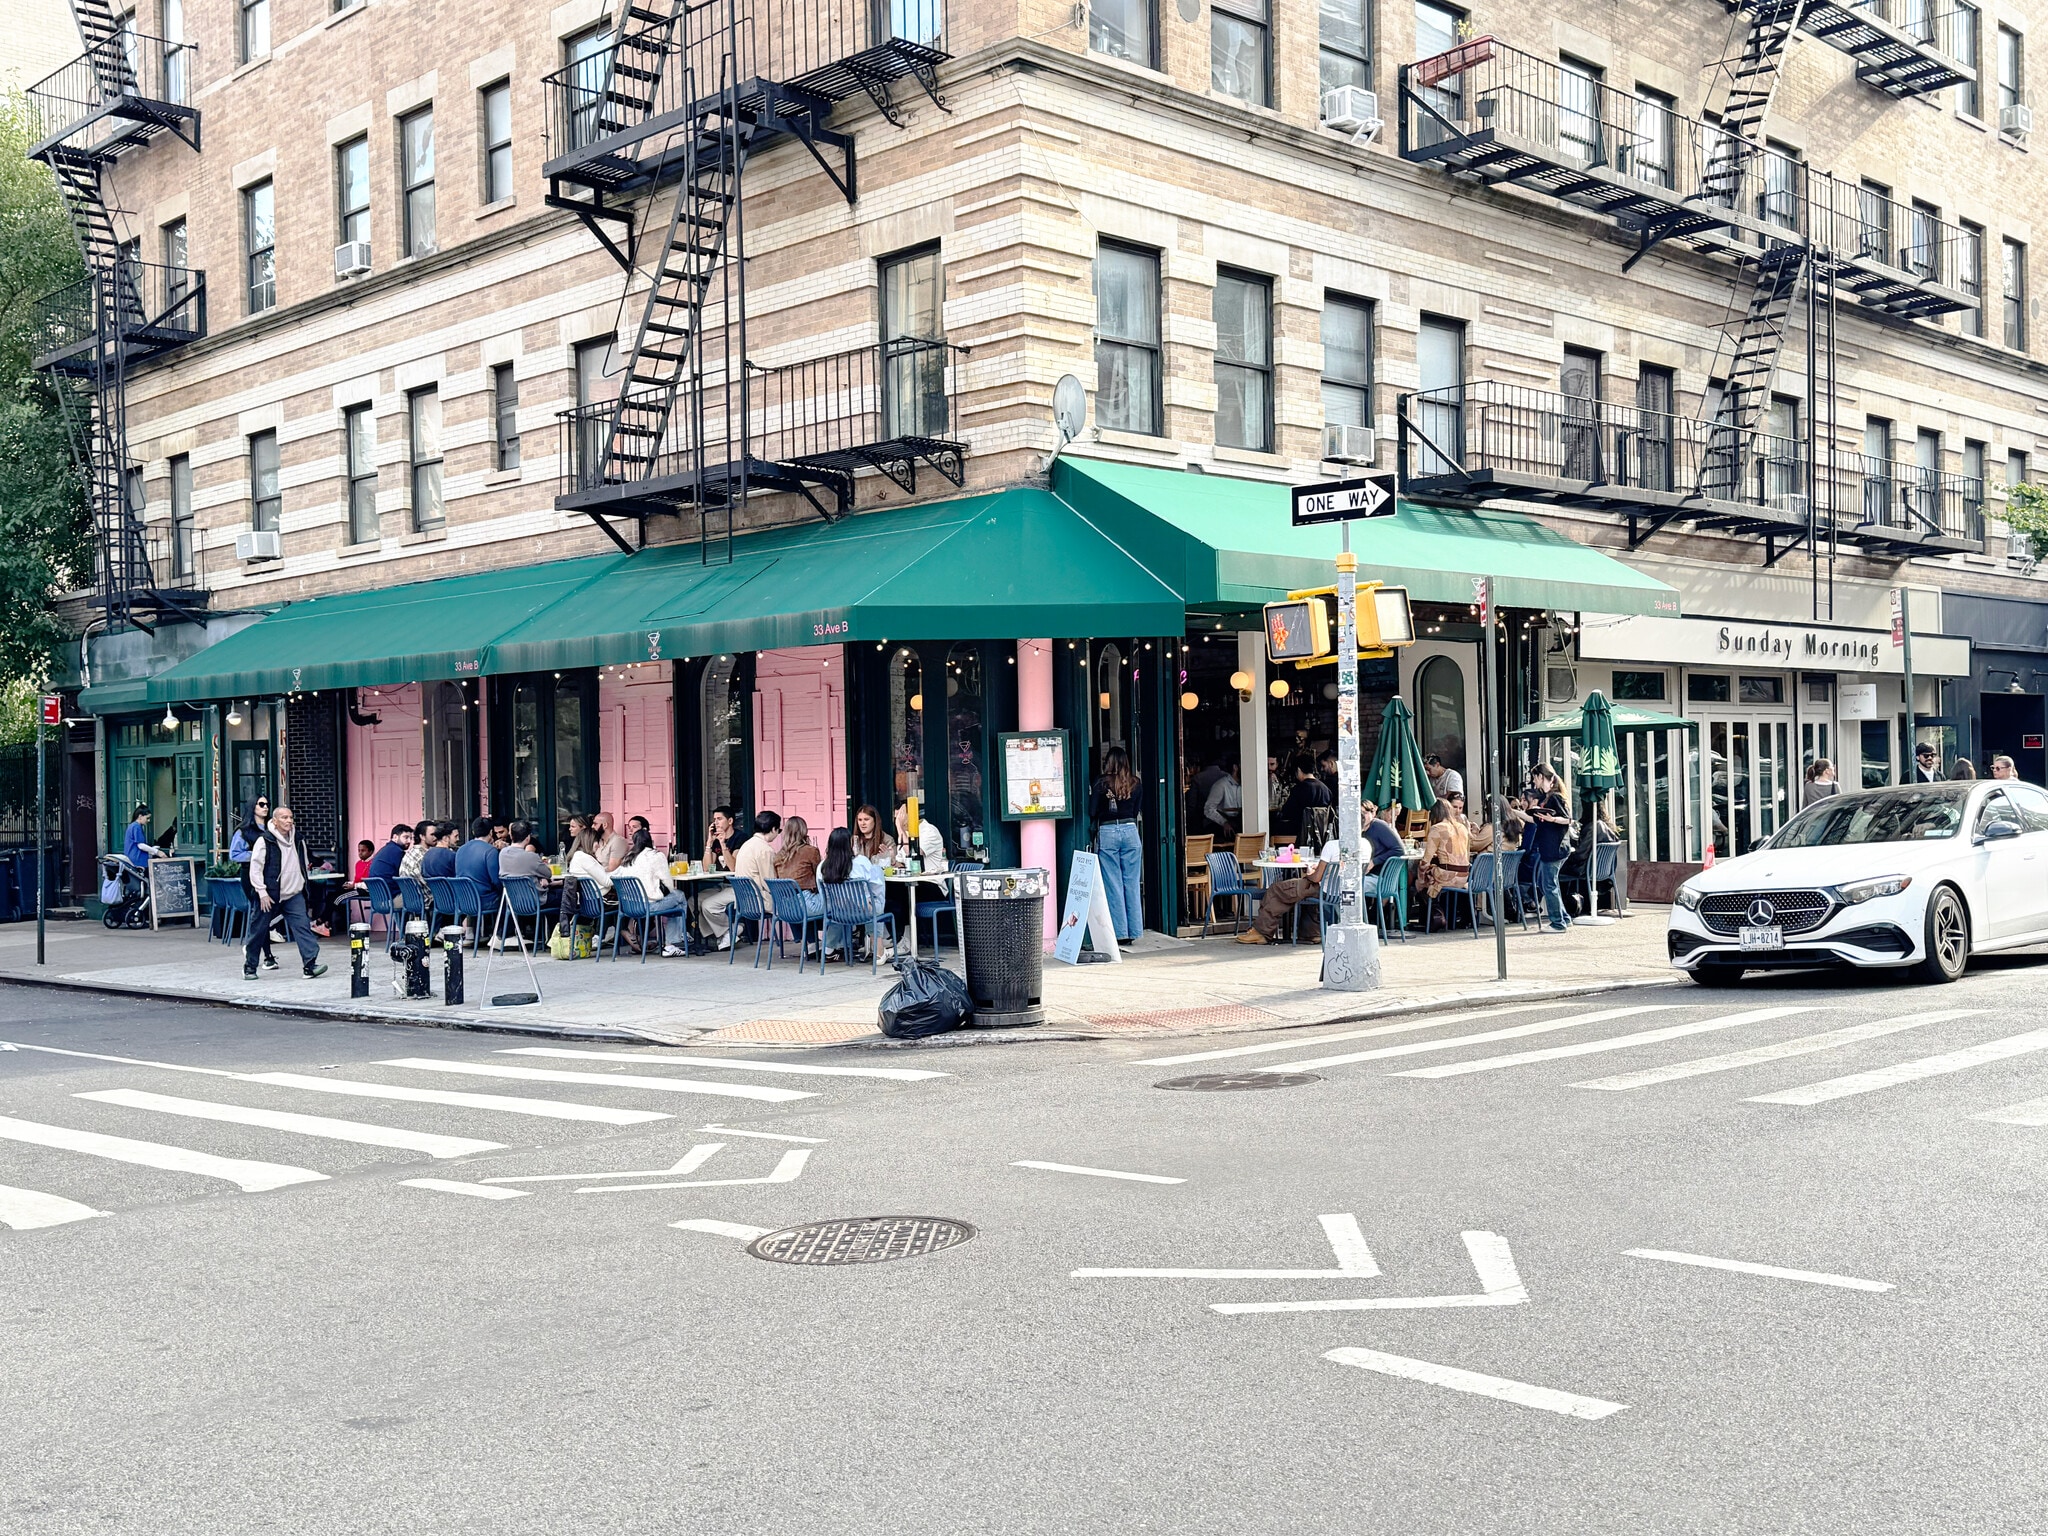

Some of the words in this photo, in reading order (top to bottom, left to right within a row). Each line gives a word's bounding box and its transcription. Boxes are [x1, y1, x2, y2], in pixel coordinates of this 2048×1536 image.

[1306, 494, 1335, 512] ONE
[1348, 488, 1379, 507] WAY
[1654, 600, 1662, 610] 33
[1662, 601, 1672, 611] Ave
[1672, 601, 1678, 611] B
[813, 624, 824, 636] 33
[825, 623, 841, 635] Ave
[841, 620, 849, 633] B
[1719, 627, 1792, 661] Sunday
[1805, 633, 1879, 666] Morning
[454, 661, 463, 671] 33
[463, 660, 473, 670] Ave
[473, 659, 479, 670] B
[983, 878, 1001, 890] COOP
